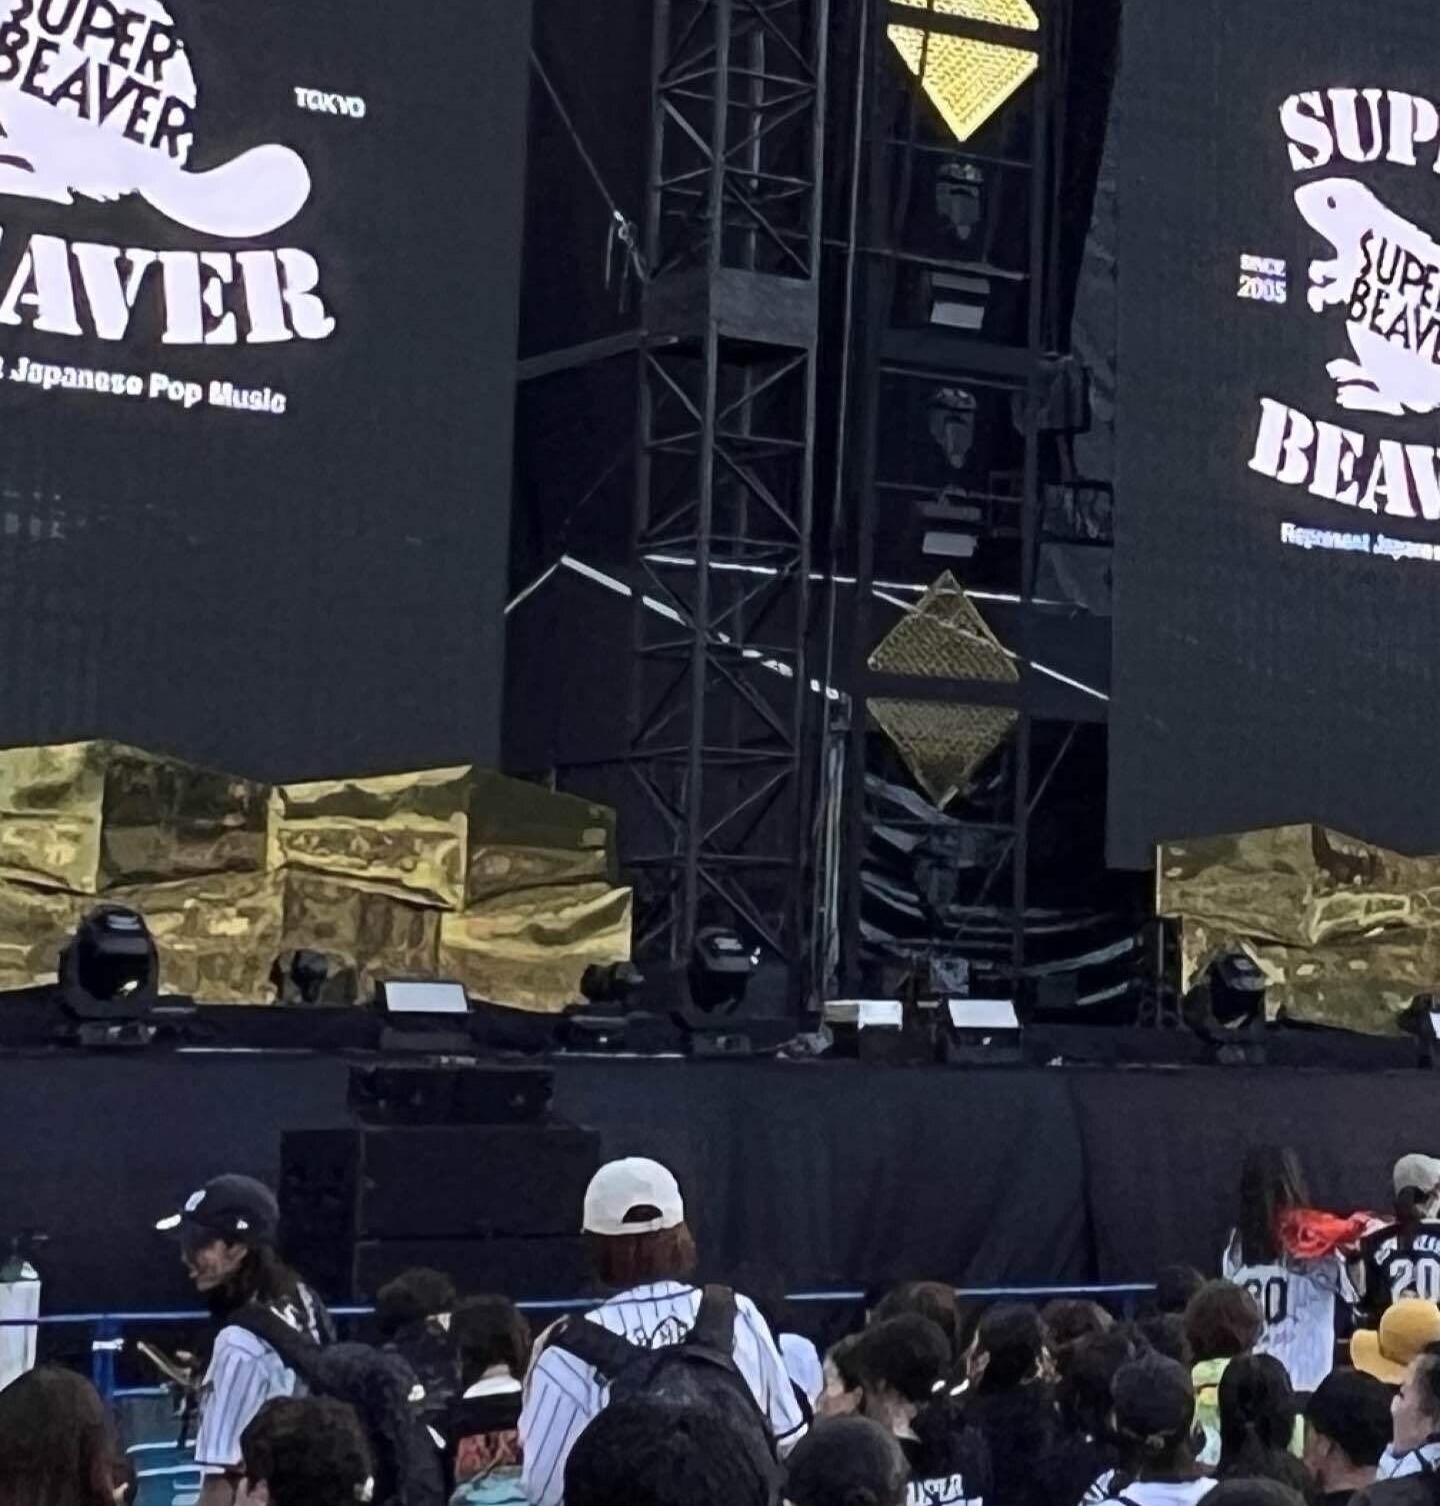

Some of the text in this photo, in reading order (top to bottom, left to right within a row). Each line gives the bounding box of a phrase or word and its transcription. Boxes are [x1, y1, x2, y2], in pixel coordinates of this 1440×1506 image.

[294, 87, 366, 118] TOKYO
[9, 356, 144, 396] Japanese
[149, 372, 203, 409] Pop
[209, 380, 288, 414] Music
